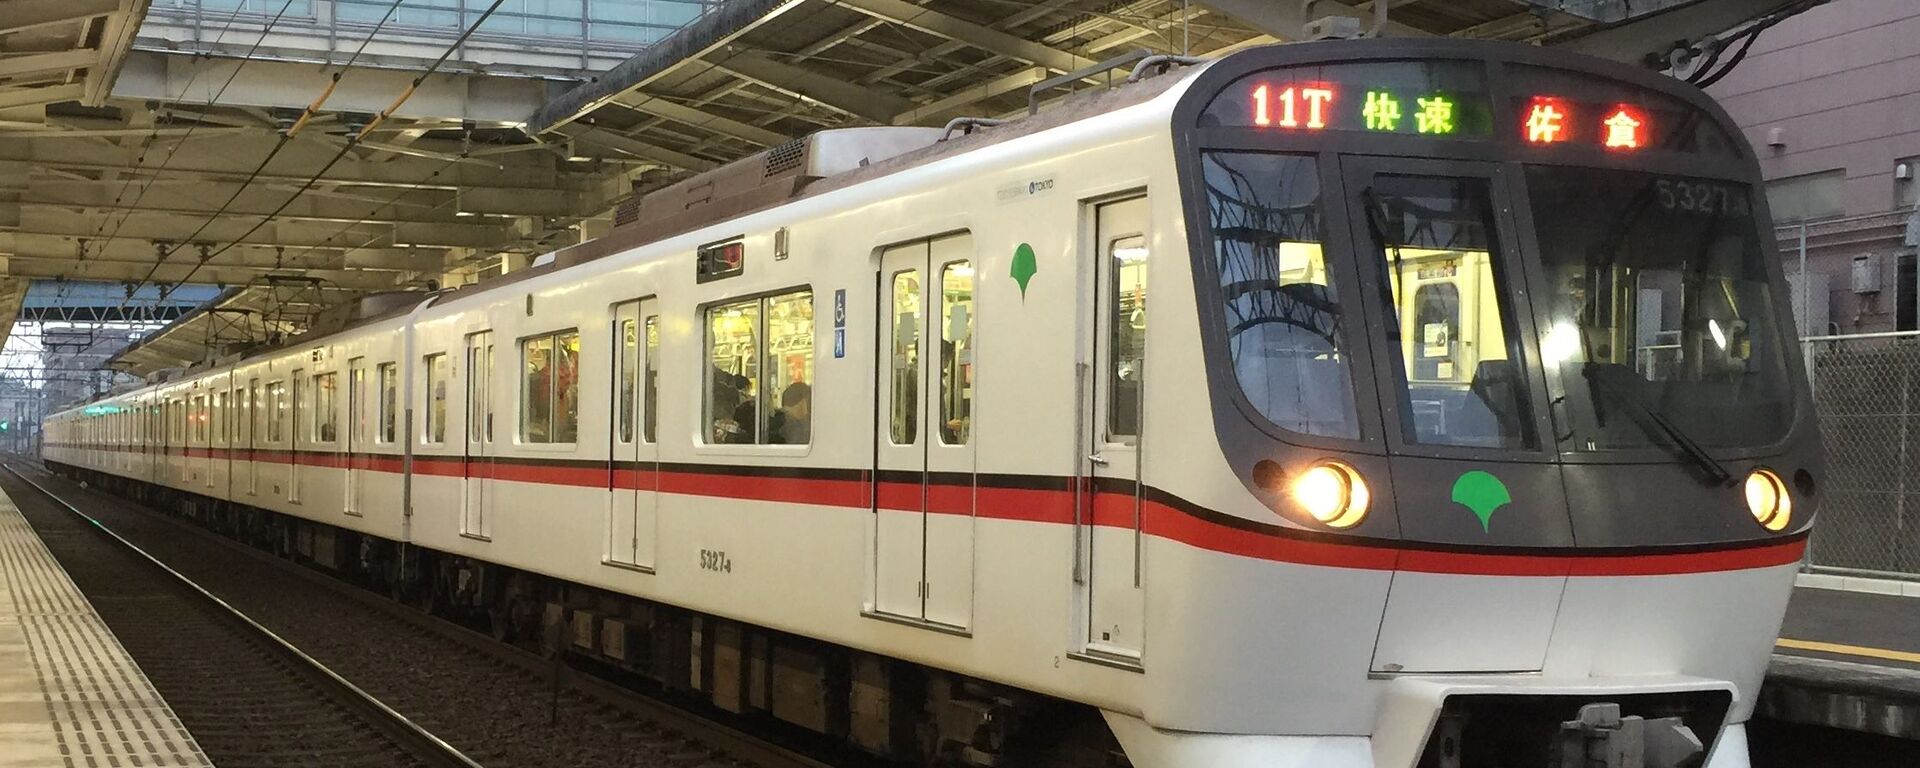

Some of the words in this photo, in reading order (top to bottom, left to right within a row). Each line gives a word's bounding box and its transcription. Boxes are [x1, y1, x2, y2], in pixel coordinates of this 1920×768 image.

[1253, 85, 1333, 129] 11T
[1362, 91, 1454, 135] 快速
[1525, 104, 1641, 149] 佐倉
